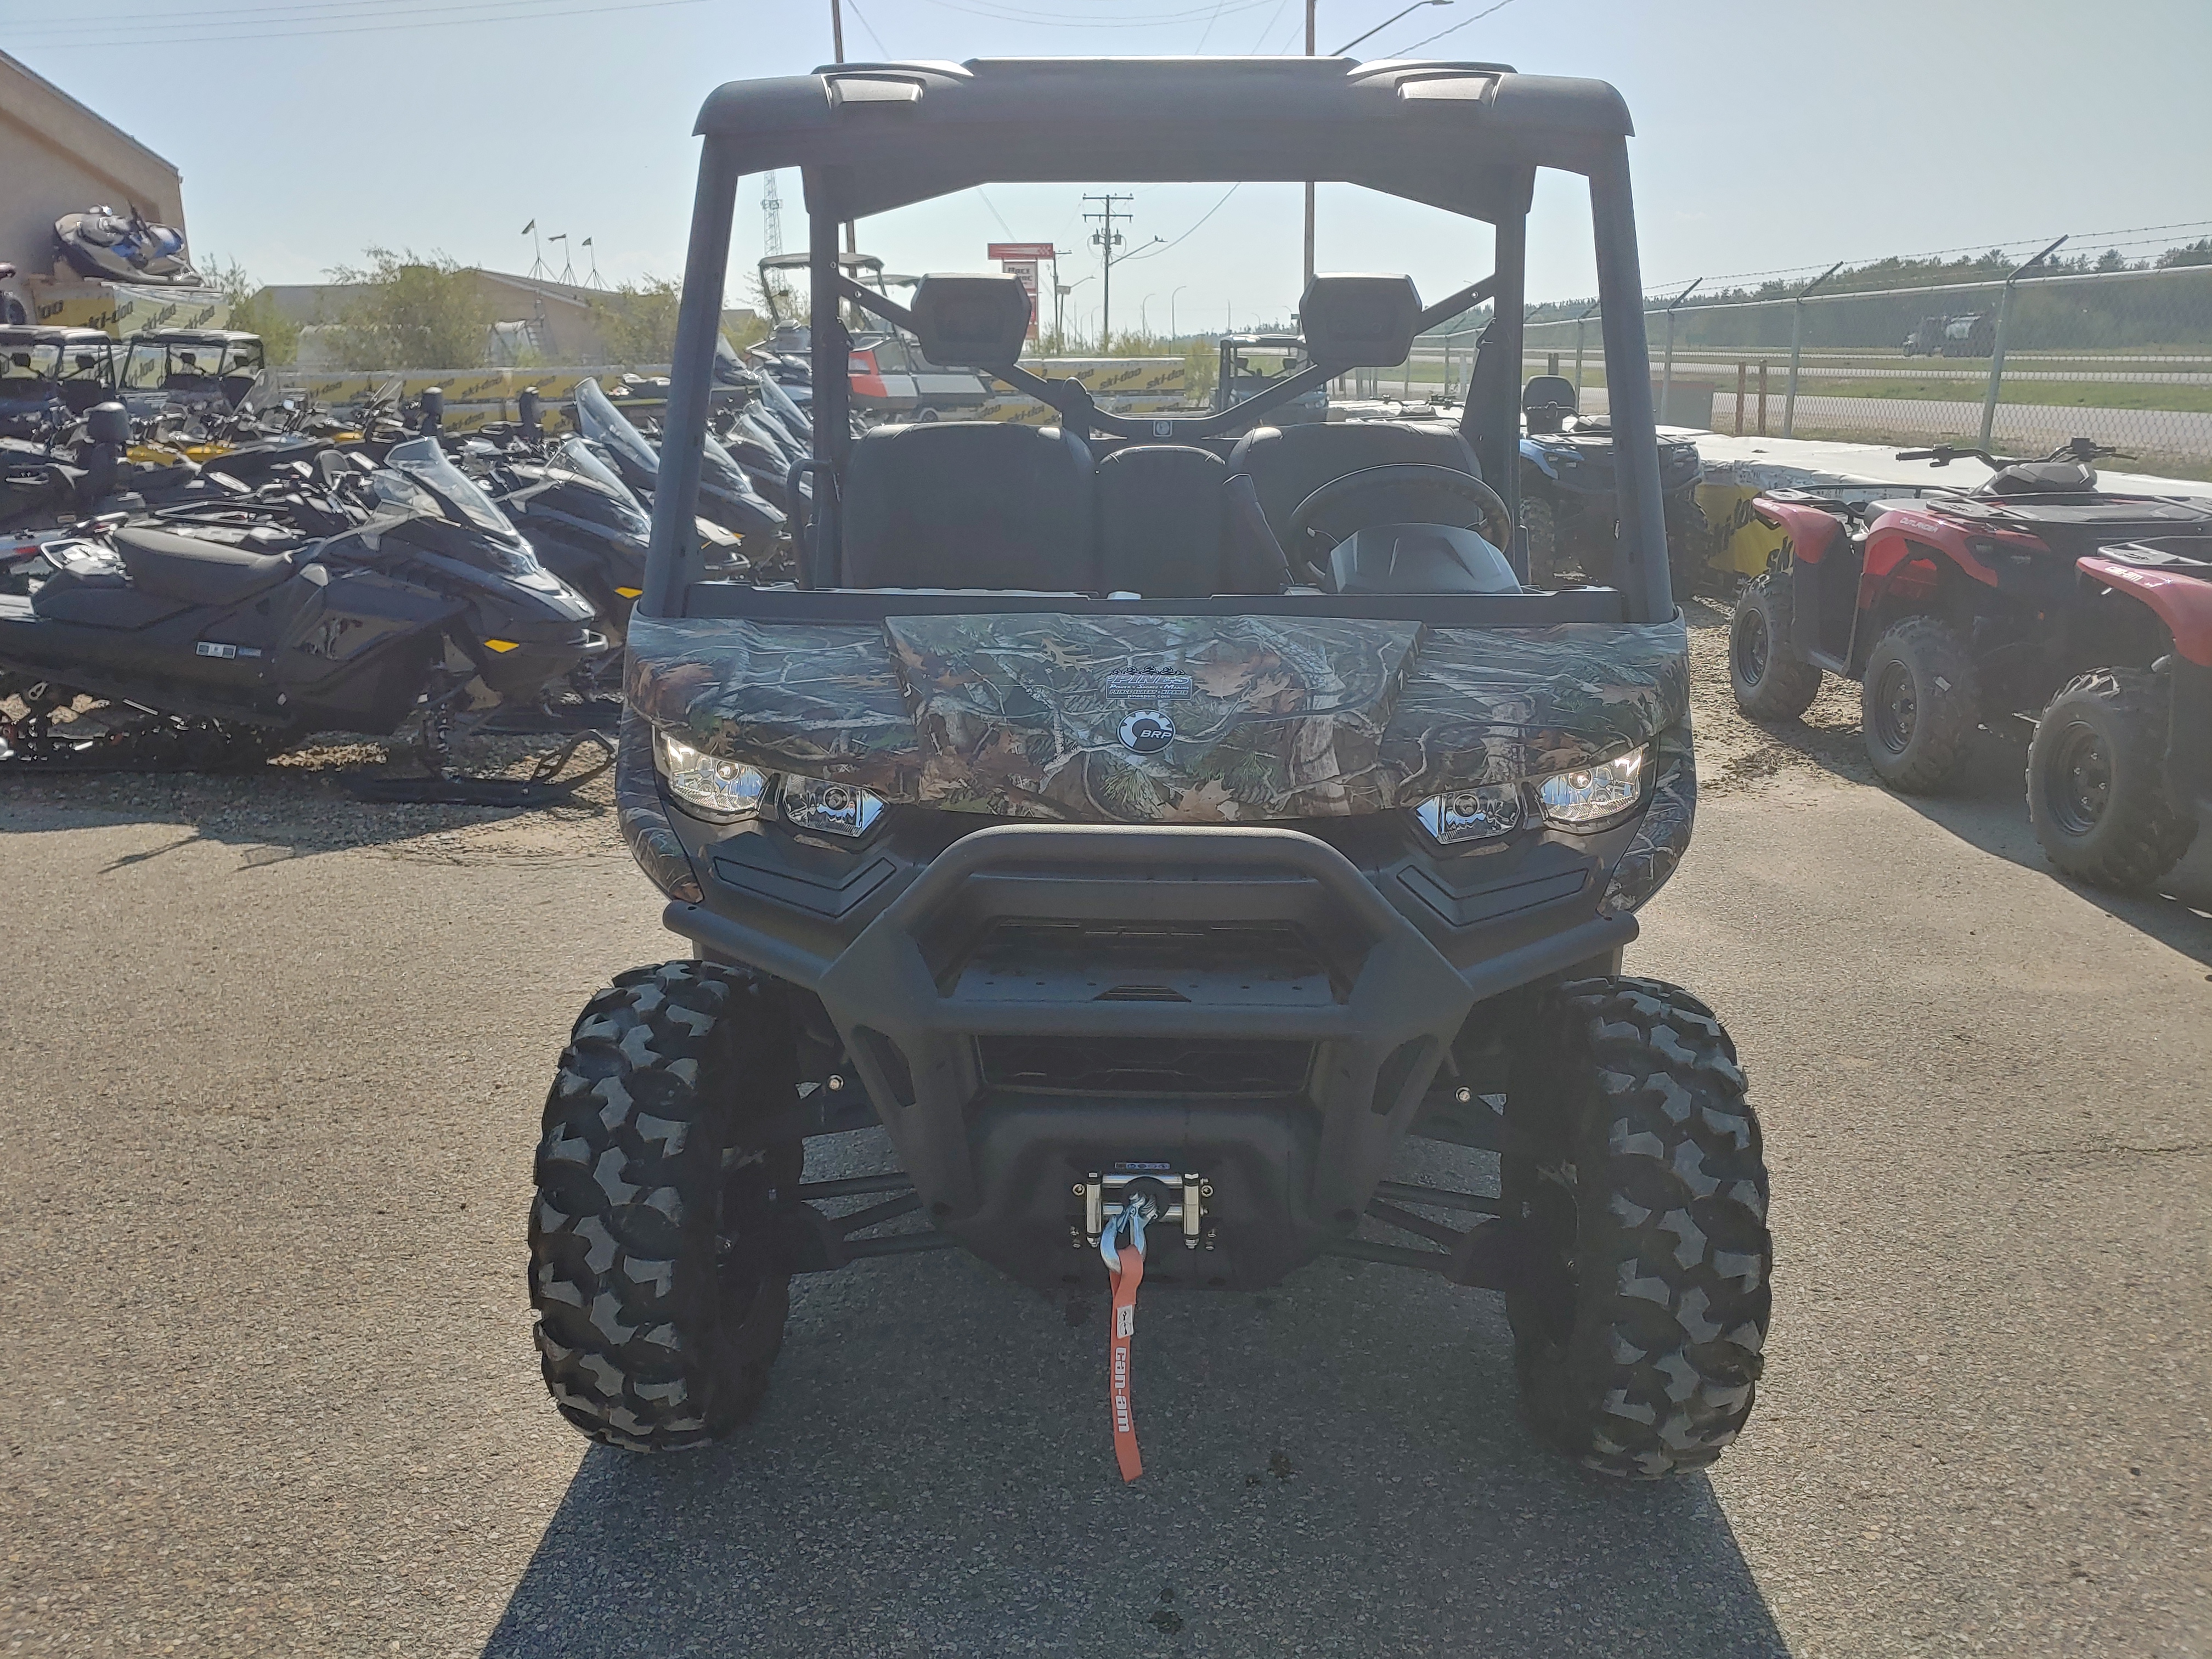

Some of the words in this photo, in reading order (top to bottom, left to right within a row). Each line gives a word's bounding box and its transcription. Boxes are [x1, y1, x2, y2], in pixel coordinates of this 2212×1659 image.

[1099, 368, 1142, 390] ski-doo
[1111, 674, 1191, 684] PINES
[1140, 730, 1172, 739] BRP
[1115, 1347, 1130, 1432] can-am
